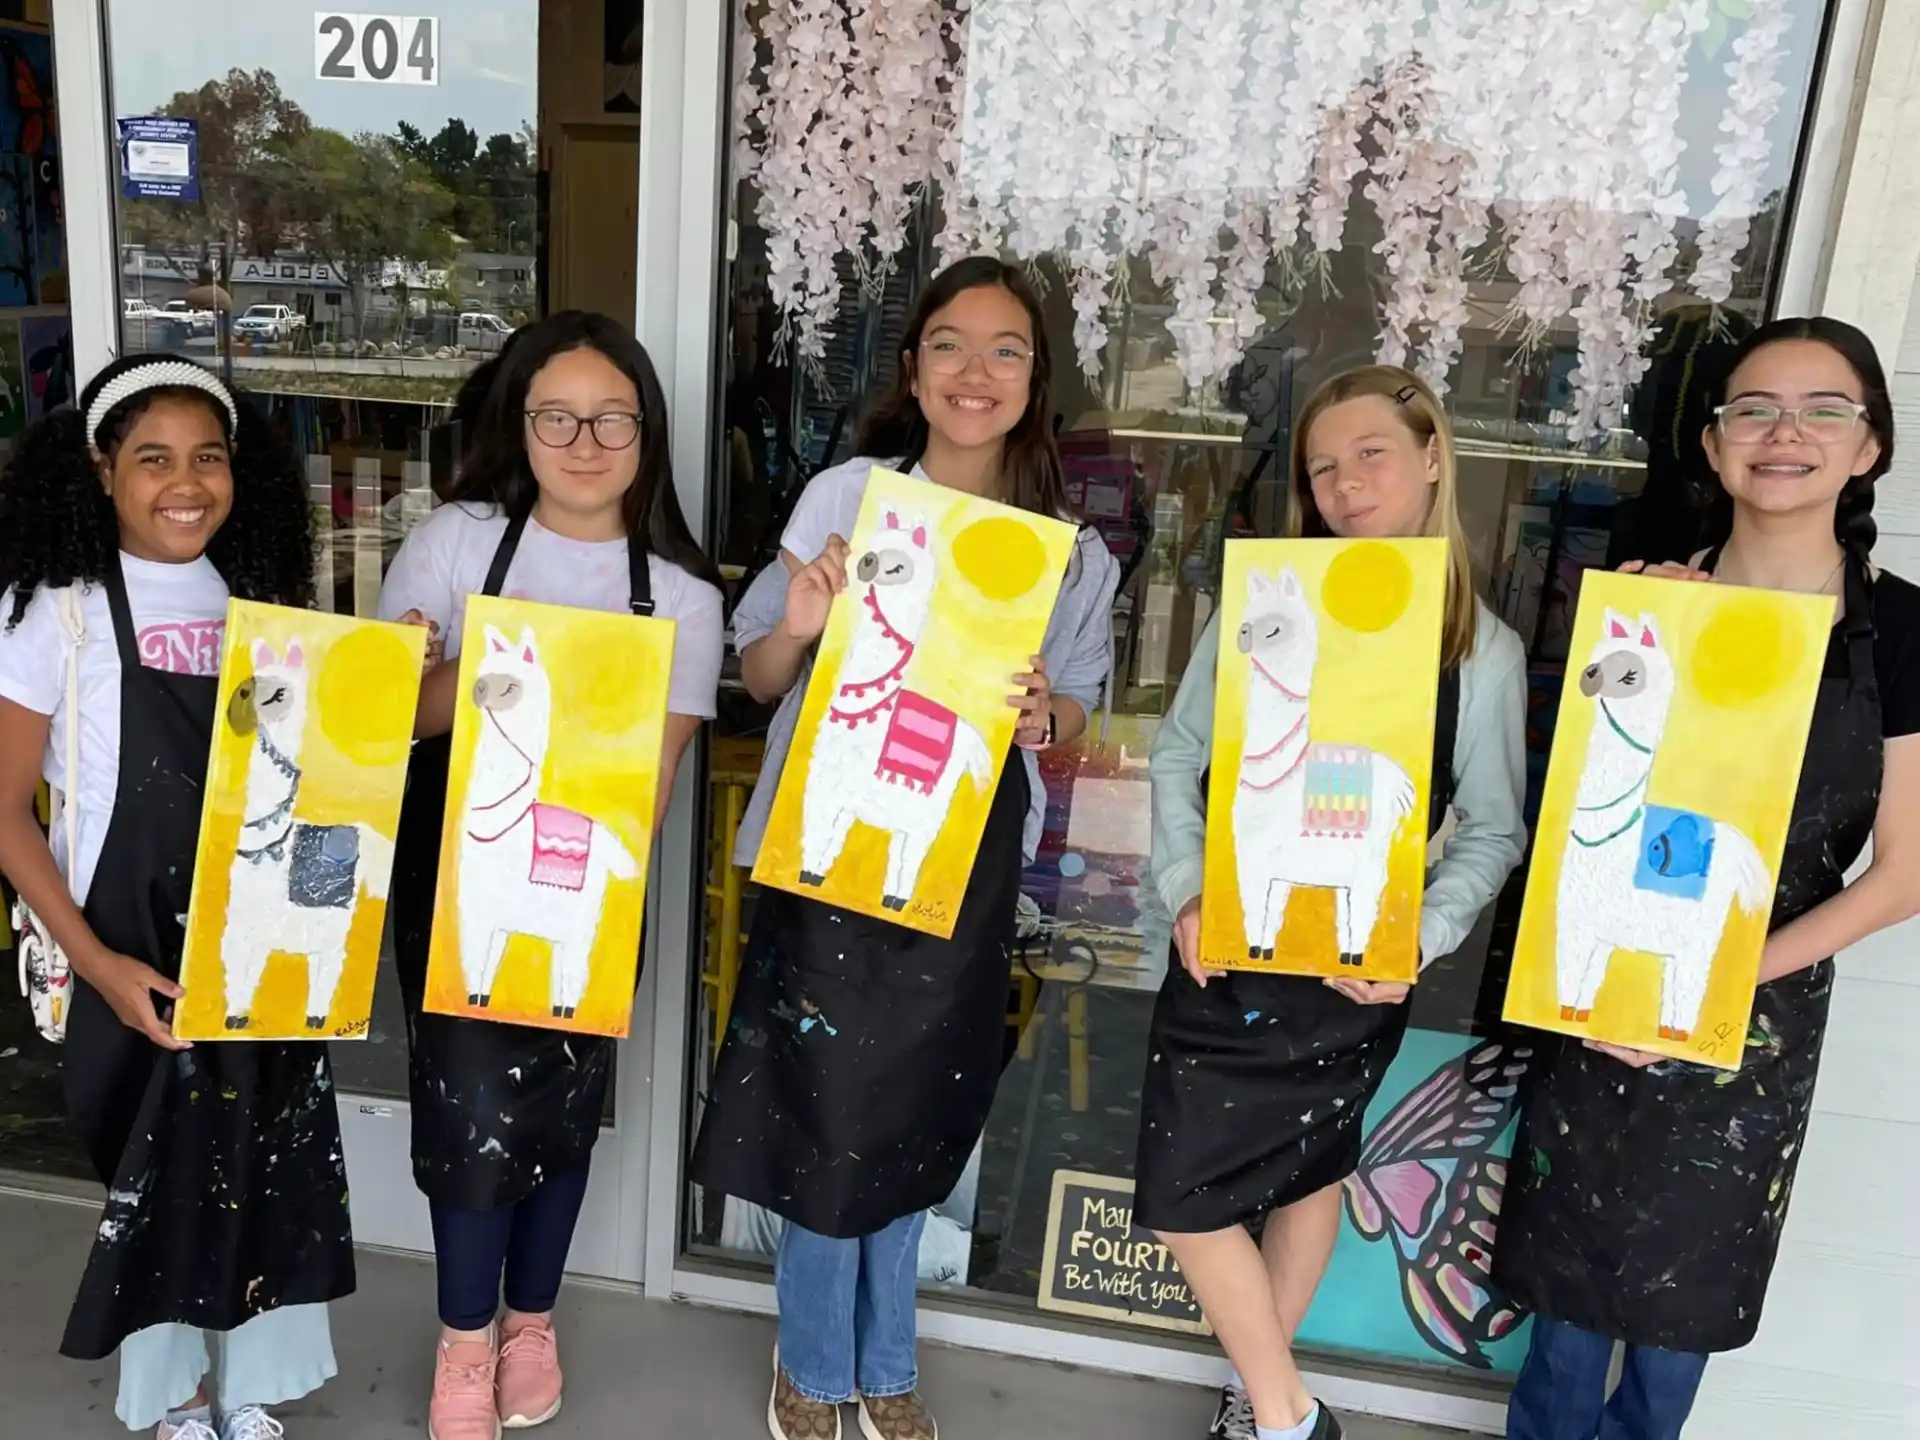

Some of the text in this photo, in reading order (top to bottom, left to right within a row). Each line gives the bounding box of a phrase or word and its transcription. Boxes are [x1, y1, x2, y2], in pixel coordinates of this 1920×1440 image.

[319, 15, 434, 80] 204
[1081, 1196, 1133, 1240] May
[1070, 1230, 1180, 1272] FOURT
[1062, 1264, 1094, 1290] Be
